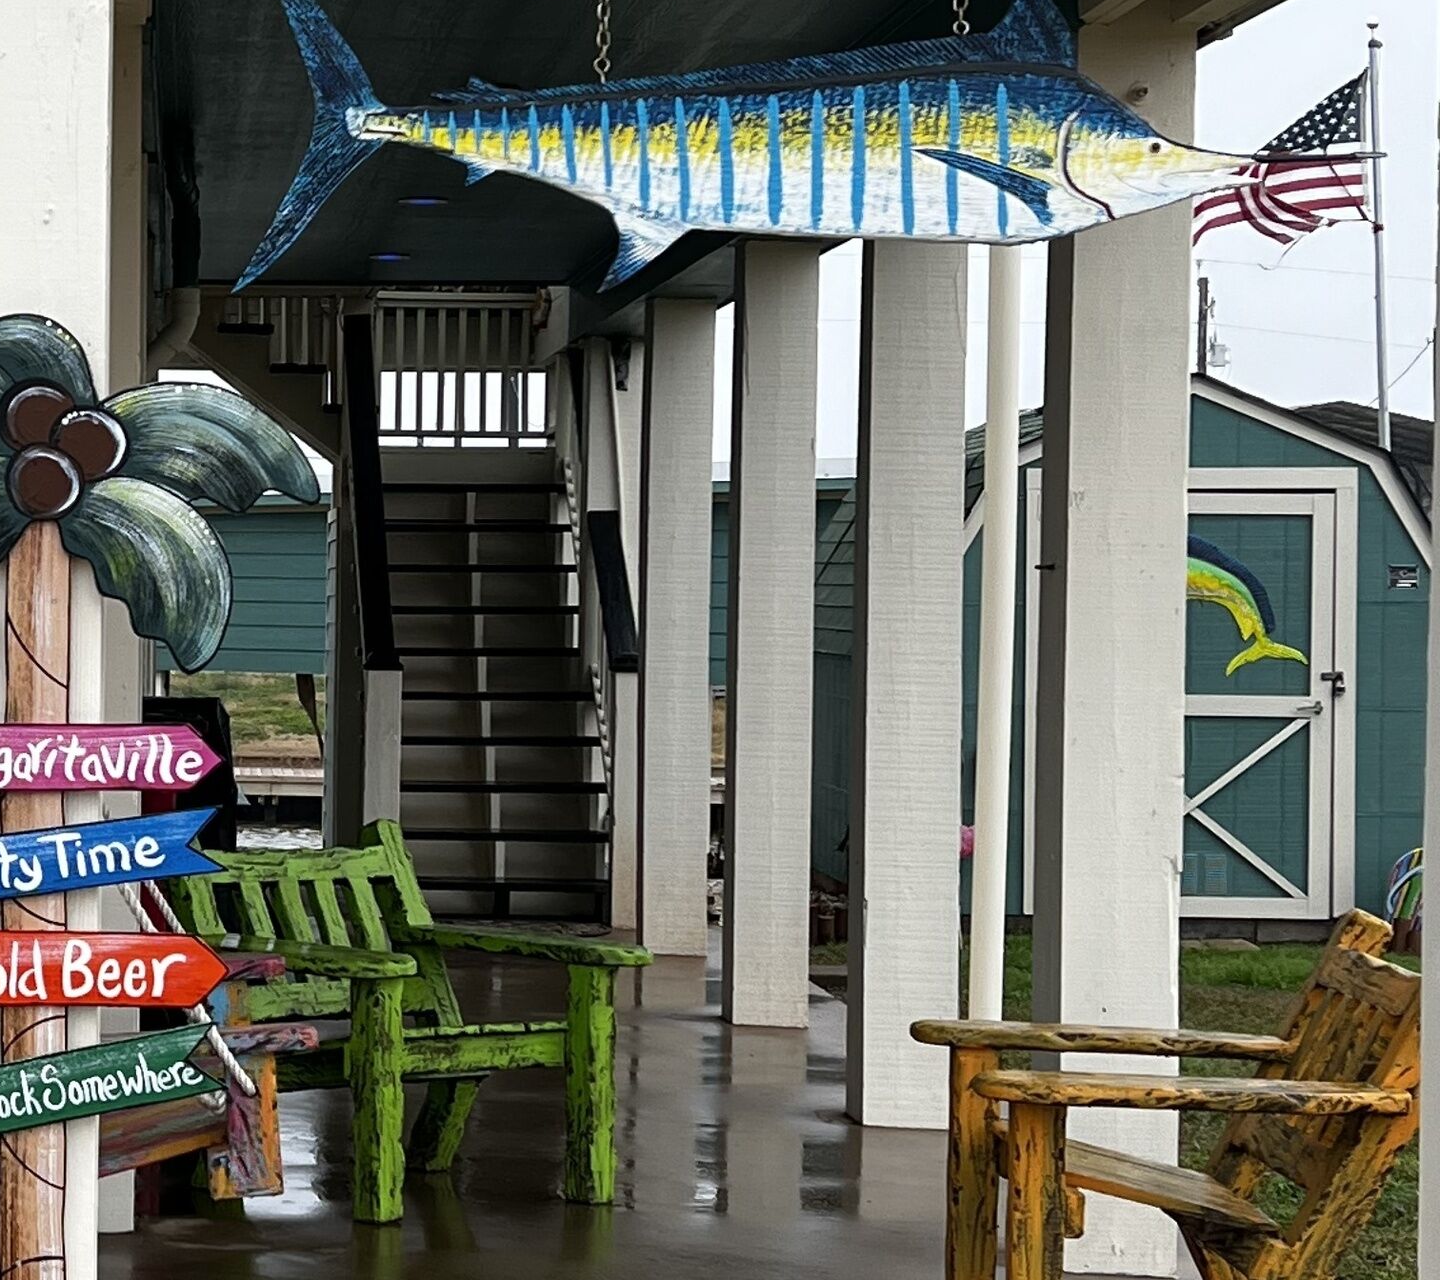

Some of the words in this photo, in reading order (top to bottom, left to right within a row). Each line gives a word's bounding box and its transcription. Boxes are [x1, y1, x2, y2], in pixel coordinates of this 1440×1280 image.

[37, 832, 166, 879] Time
[62, 939, 187, 999] Beer
[40, 1052, 204, 1111] Somewhere
